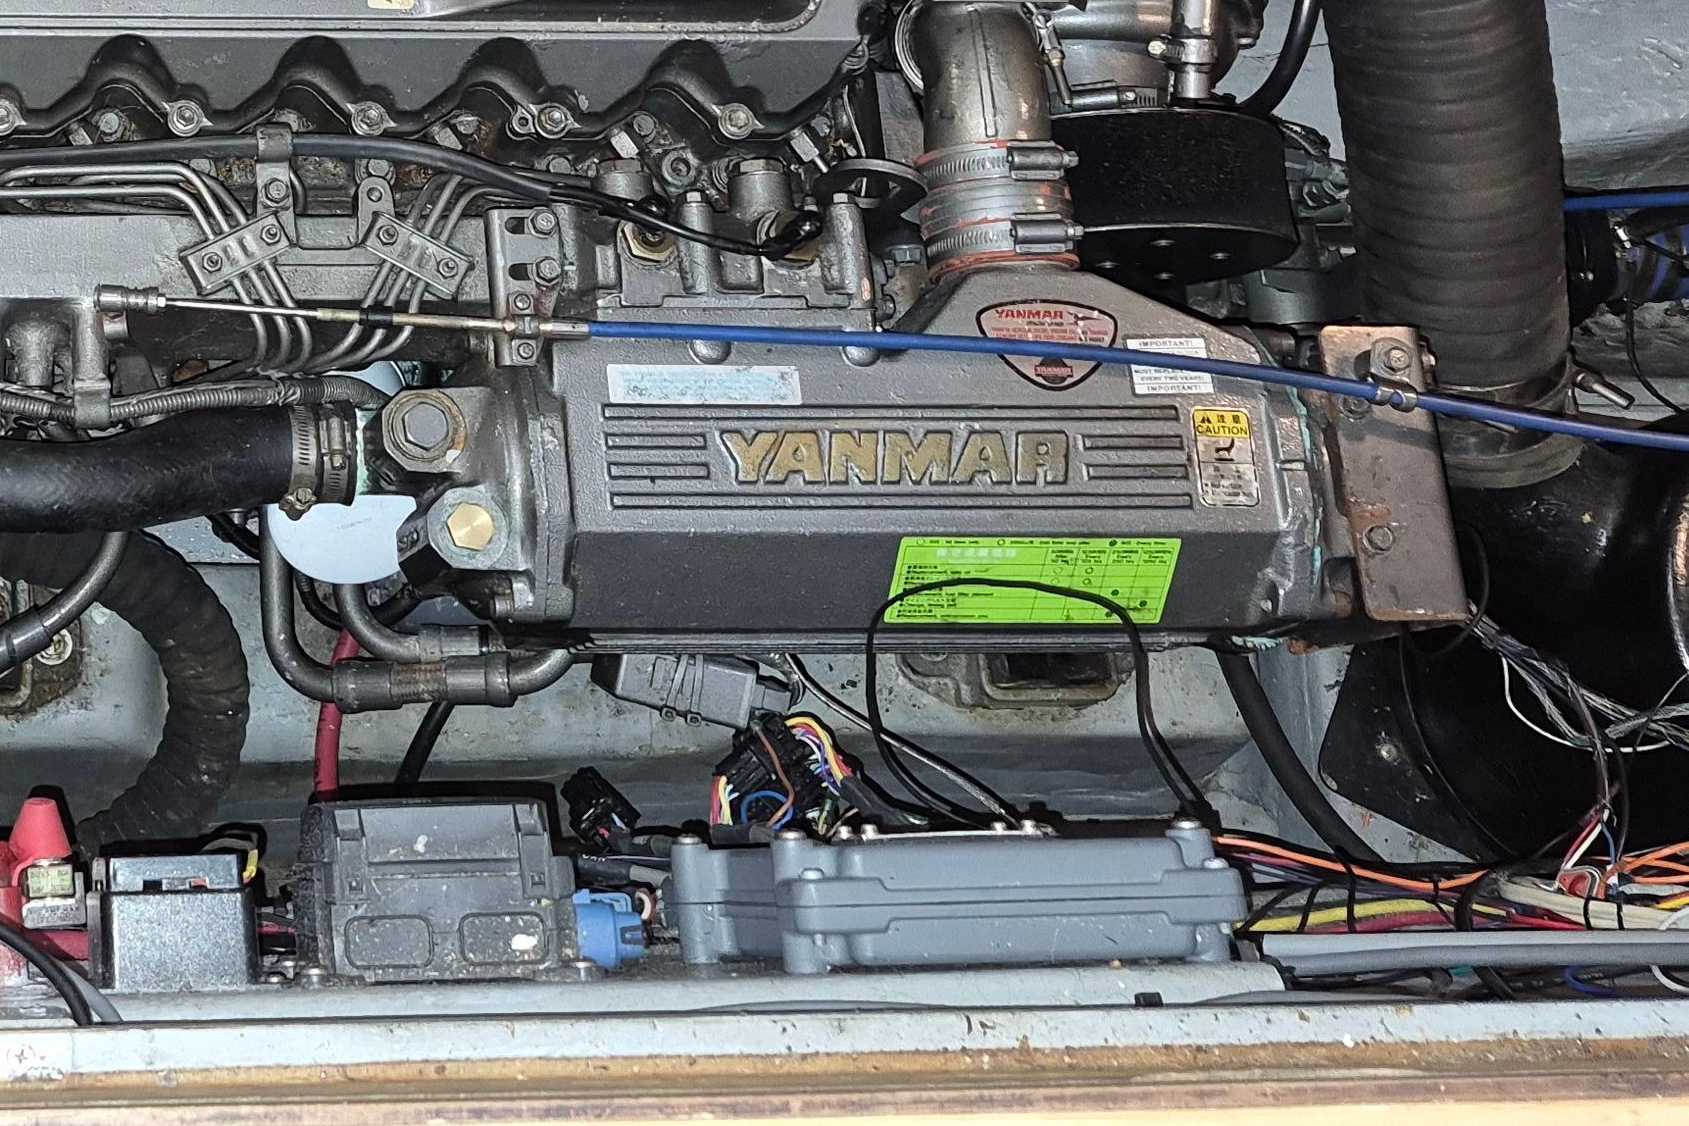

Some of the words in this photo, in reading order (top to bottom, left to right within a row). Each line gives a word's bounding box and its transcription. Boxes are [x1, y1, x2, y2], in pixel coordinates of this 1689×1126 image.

[994, 309, 1064, 320] YANMAR
[1196, 425, 1248, 436] CAUTION
[719, 429, 1070, 486] YANMAR
